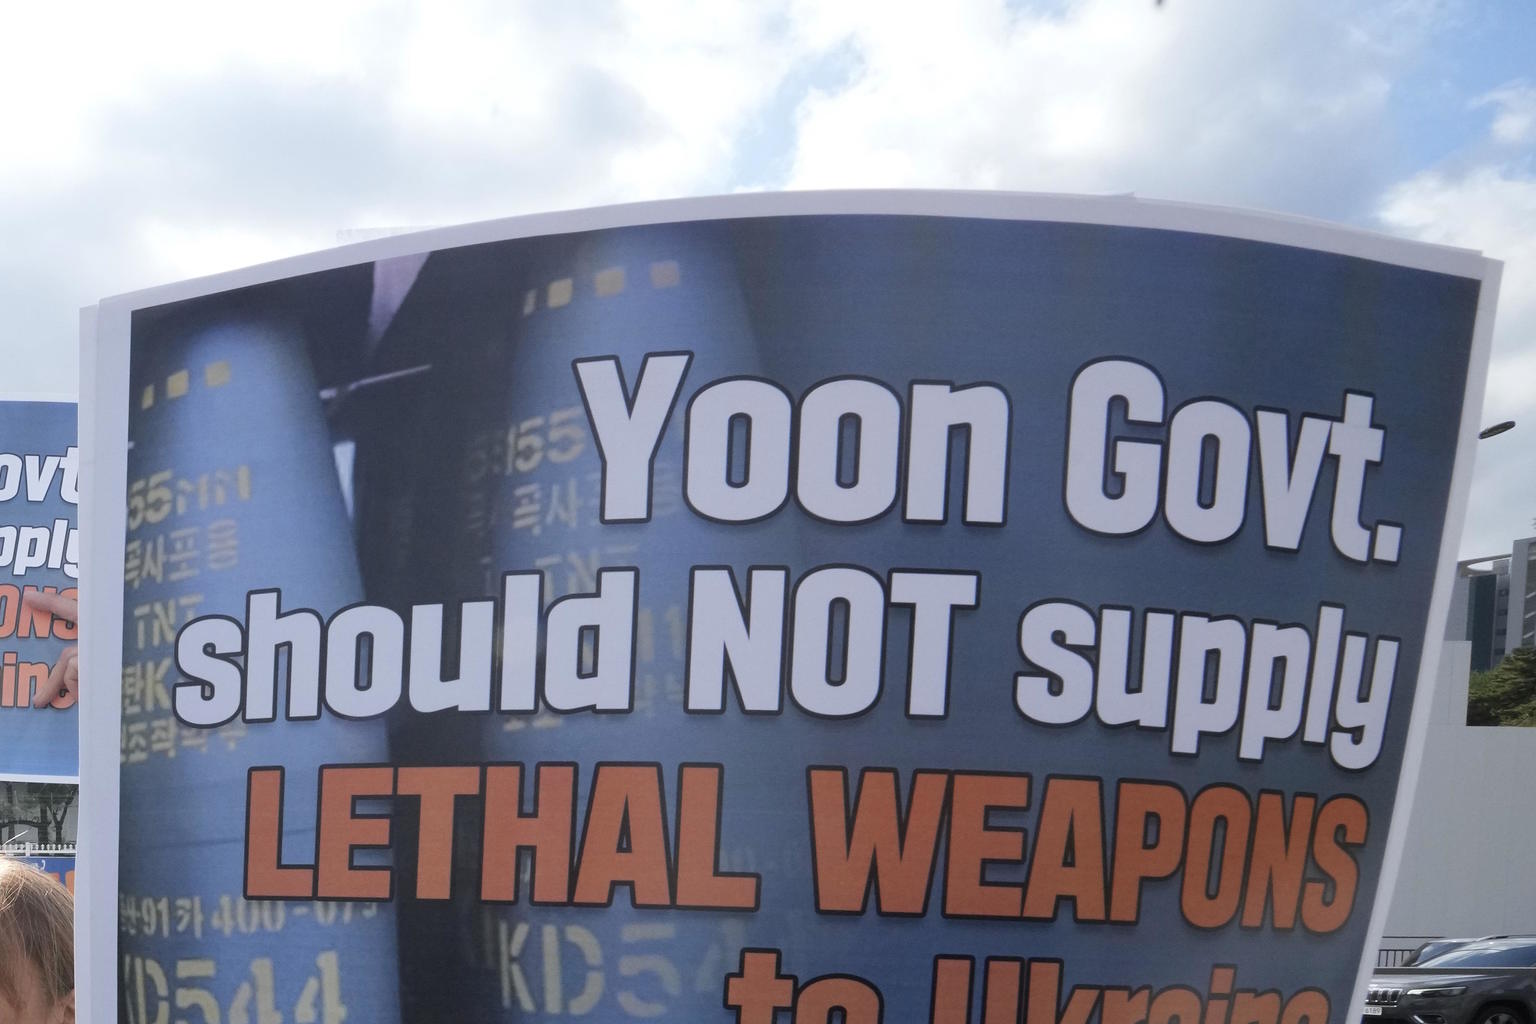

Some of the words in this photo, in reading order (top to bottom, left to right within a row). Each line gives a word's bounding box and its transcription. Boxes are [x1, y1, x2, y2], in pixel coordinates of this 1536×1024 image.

[574, 353, 1009, 522] Yoon
[1066, 360, 1400, 562] Govt.
[175, 570, 637, 725] should
[686, 567, 978, 716] NOT
[1016, 602, 1398, 769] supply
[247, 764, 758, 908] LETHAL
[809, 768, 1366, 930] WEAPONS
